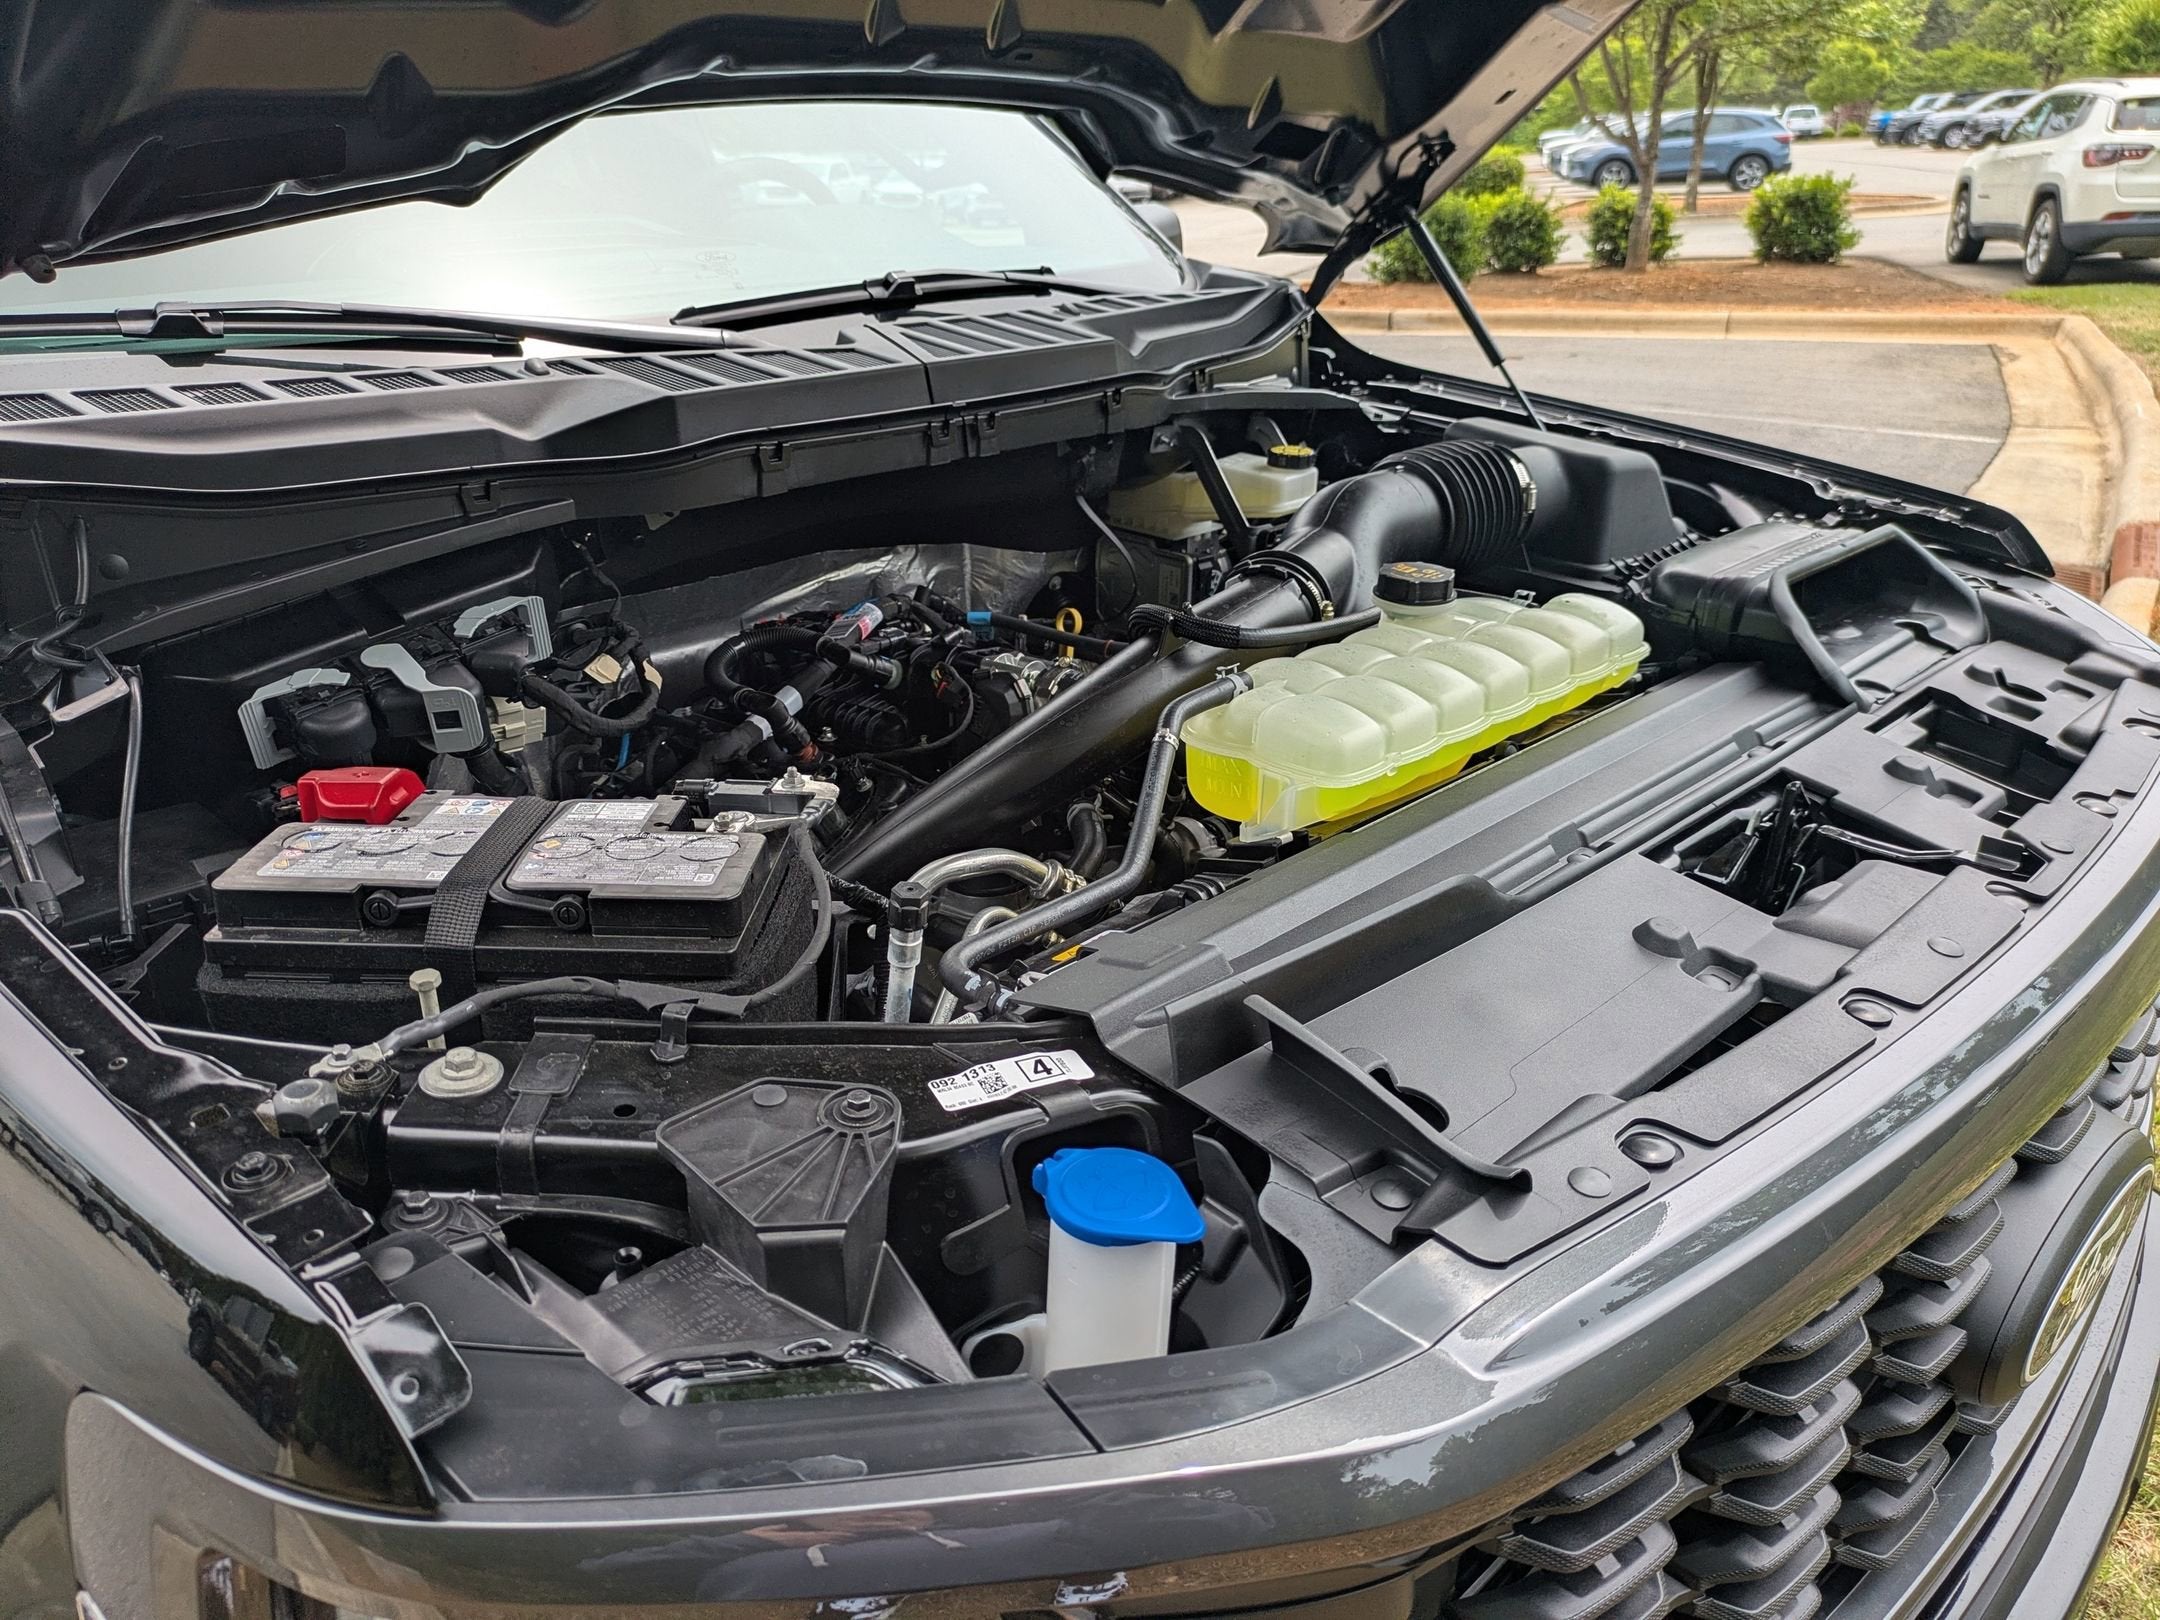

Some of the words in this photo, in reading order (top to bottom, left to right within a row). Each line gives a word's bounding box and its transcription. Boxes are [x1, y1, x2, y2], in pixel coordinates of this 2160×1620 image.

[930, 1077, 956, 1090] 092
[961, 1063, 996, 1082] 1313
[1032, 1058, 1053, 1076] 4
